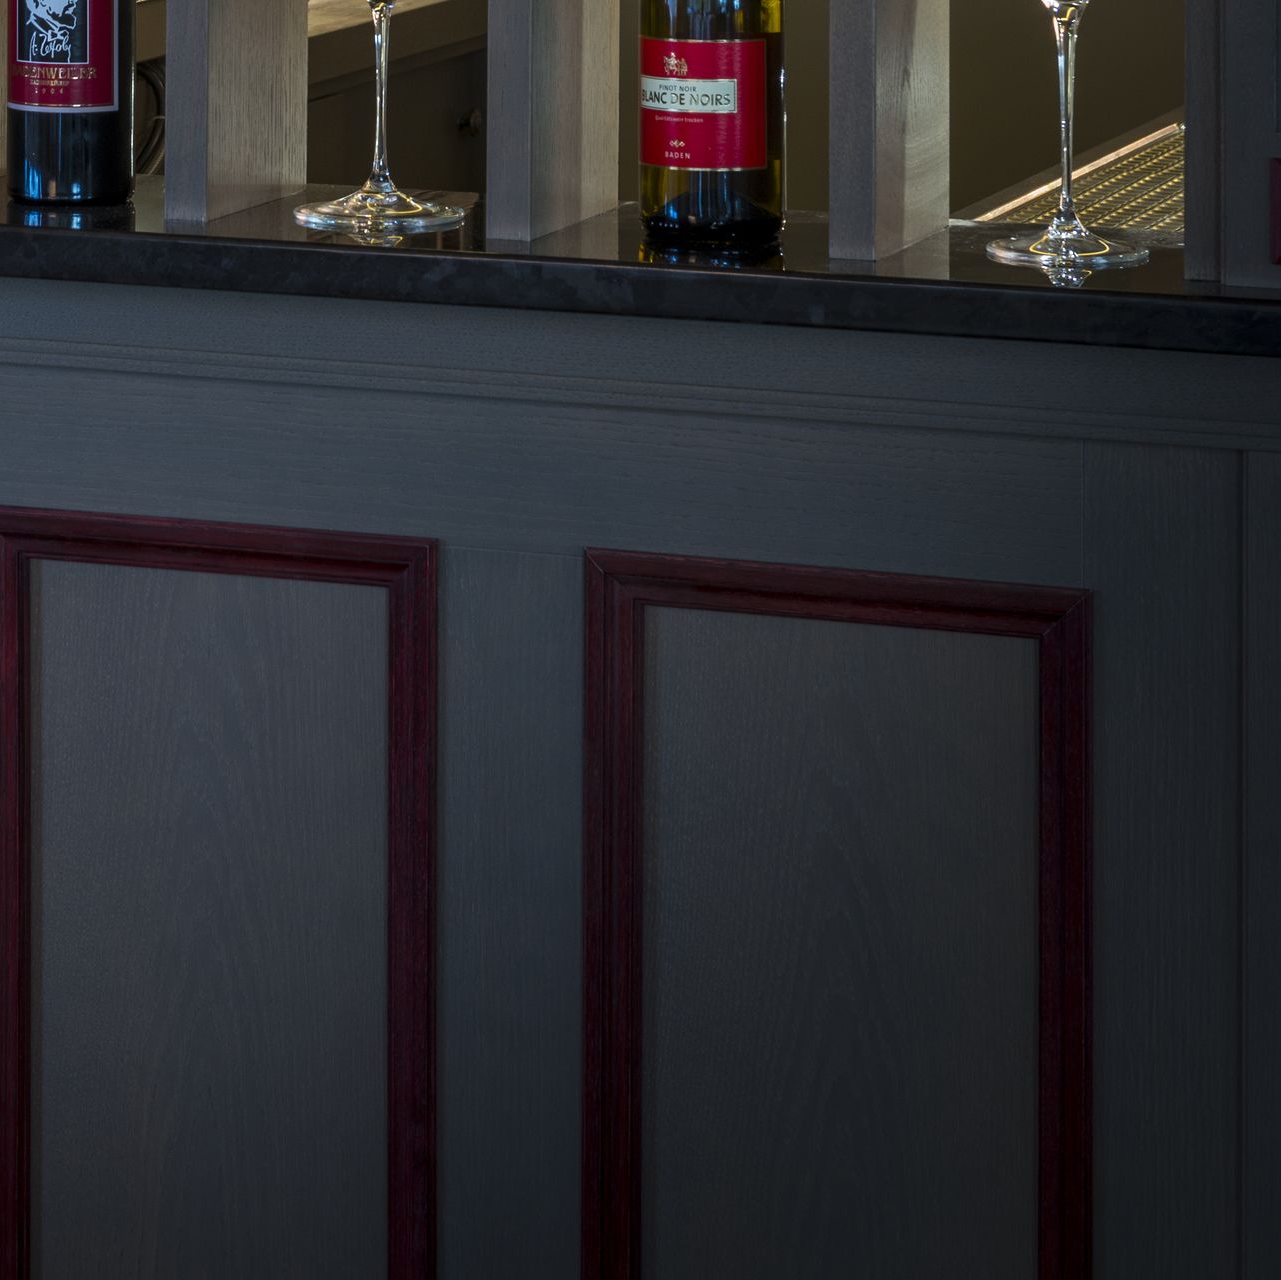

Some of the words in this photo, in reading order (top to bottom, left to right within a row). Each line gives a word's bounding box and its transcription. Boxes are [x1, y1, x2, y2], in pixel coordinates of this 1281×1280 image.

[641, 89, 667, 105] BLANC
[670, 92, 685, 105] DE
[689, 93, 730, 106] NOIRS
[664, 151, 690, 159] BADEN
